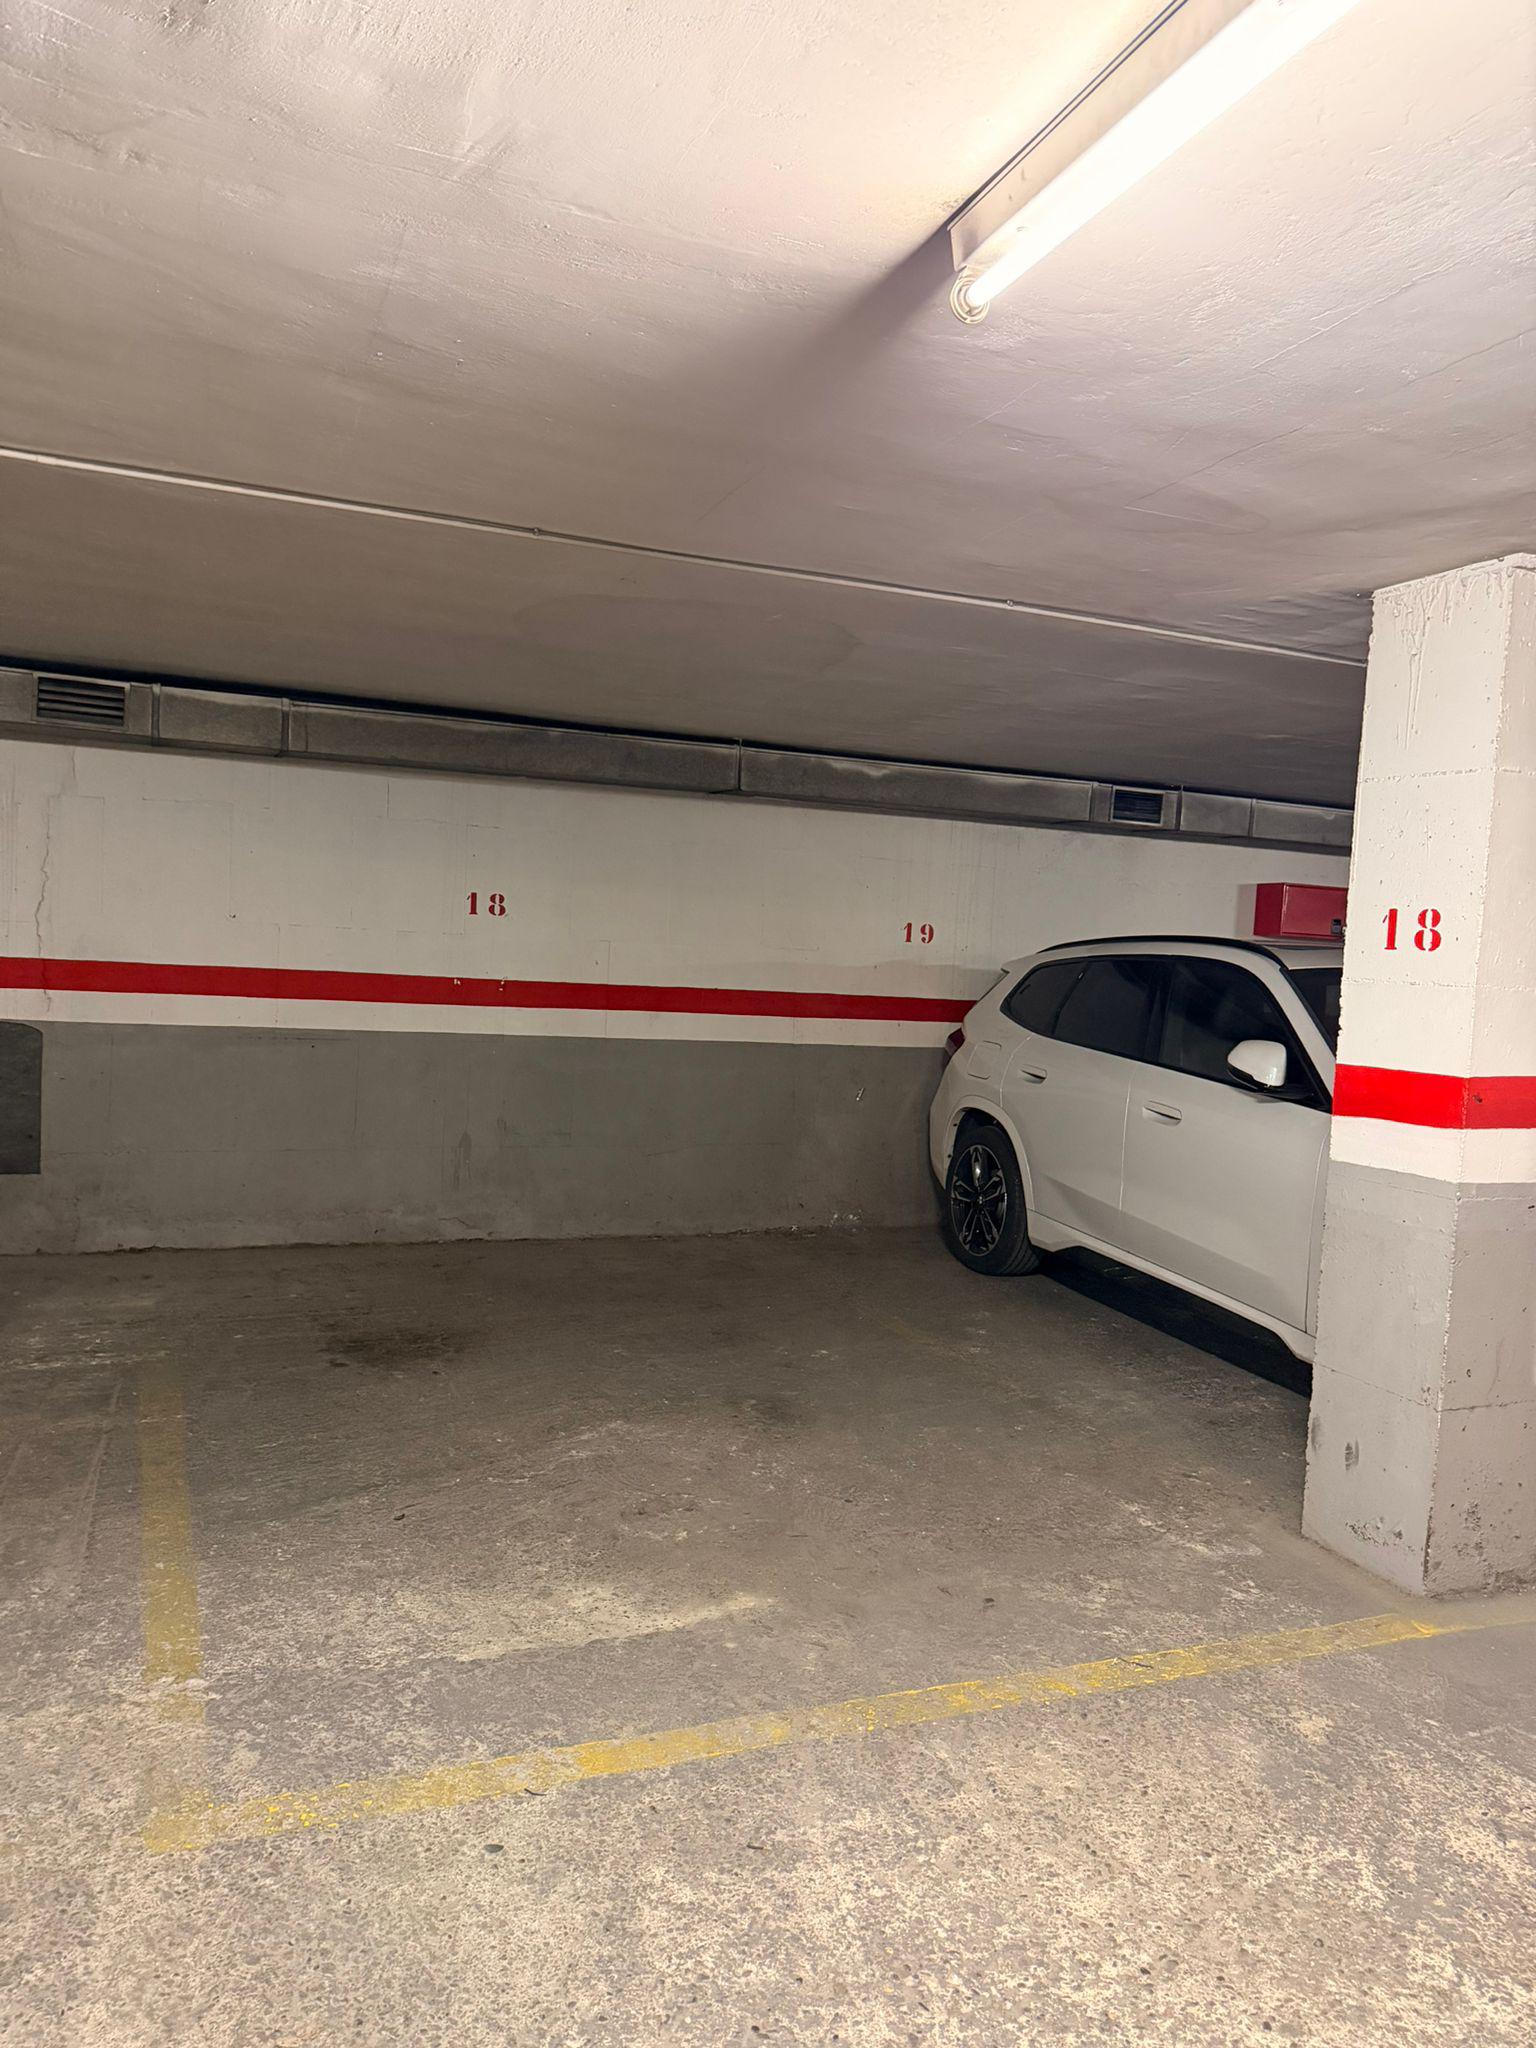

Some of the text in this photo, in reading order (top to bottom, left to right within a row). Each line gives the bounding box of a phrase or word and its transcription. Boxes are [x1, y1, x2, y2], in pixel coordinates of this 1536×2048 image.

[467, 892, 506, 916] 18
[904, 922, 934, 944] 19
[1382, 908, 1442, 952] 18
